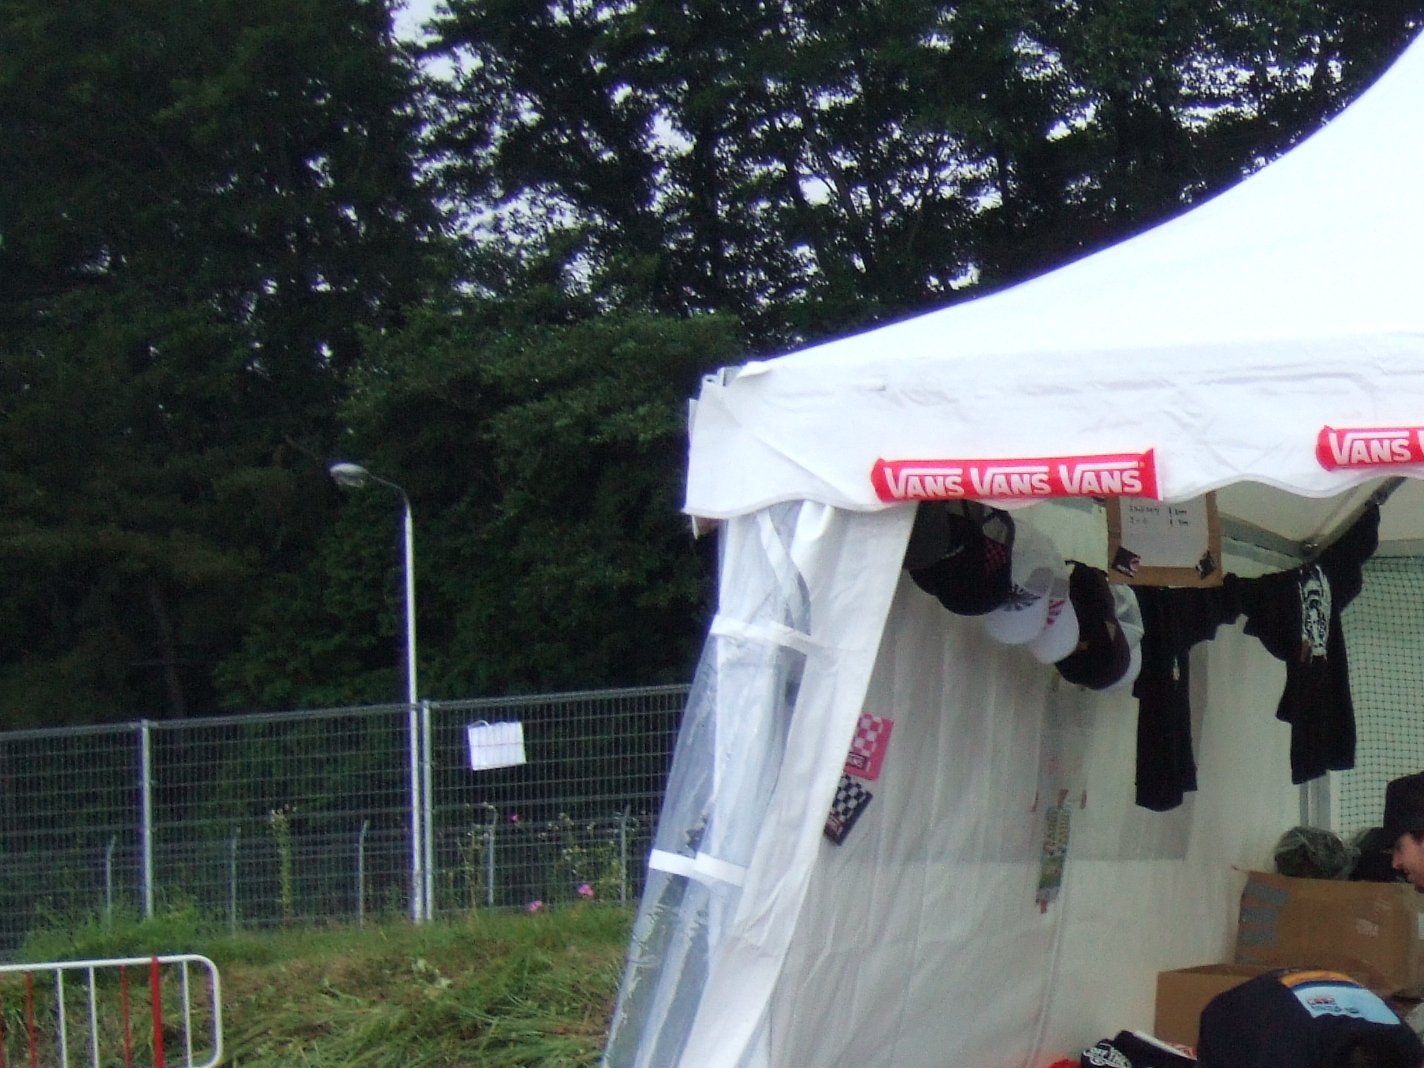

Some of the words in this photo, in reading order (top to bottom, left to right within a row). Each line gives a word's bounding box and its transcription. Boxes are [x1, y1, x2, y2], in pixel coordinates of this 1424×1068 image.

[1328, 430, 1411, 464] VANS
[884, 467, 964, 498] VANS
[970, 466, 1051, 498] VANS
[1058, 461, 1142, 495] VANS
